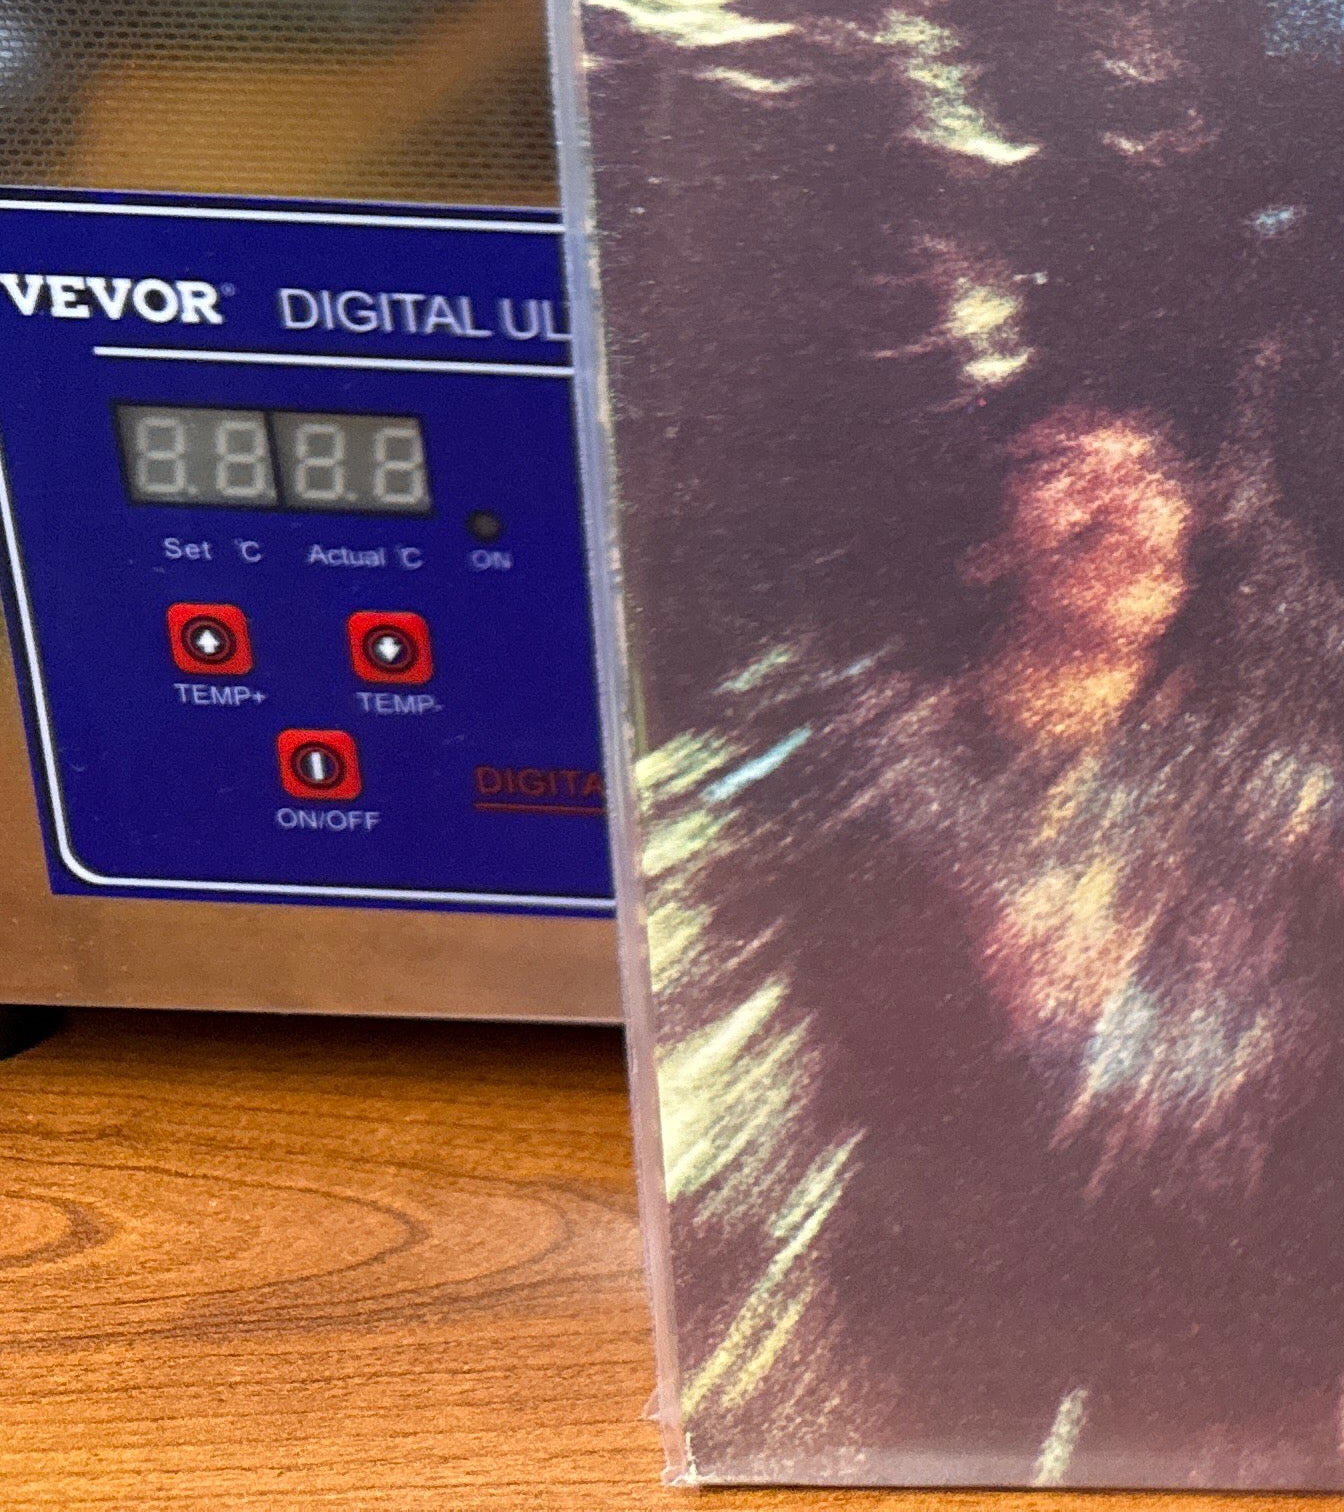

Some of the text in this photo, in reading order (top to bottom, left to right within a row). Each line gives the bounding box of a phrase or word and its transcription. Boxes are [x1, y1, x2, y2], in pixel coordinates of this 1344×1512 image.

[279, 287, 494, 338] DIGITAL
[163, 537, 213, 561] Set
[307, 544, 385, 568] Actual
[470, 548, 513, 571] ON
[173, 683, 267, 707] TEMP+
[275, 807, 382, 832] ON/OFF
